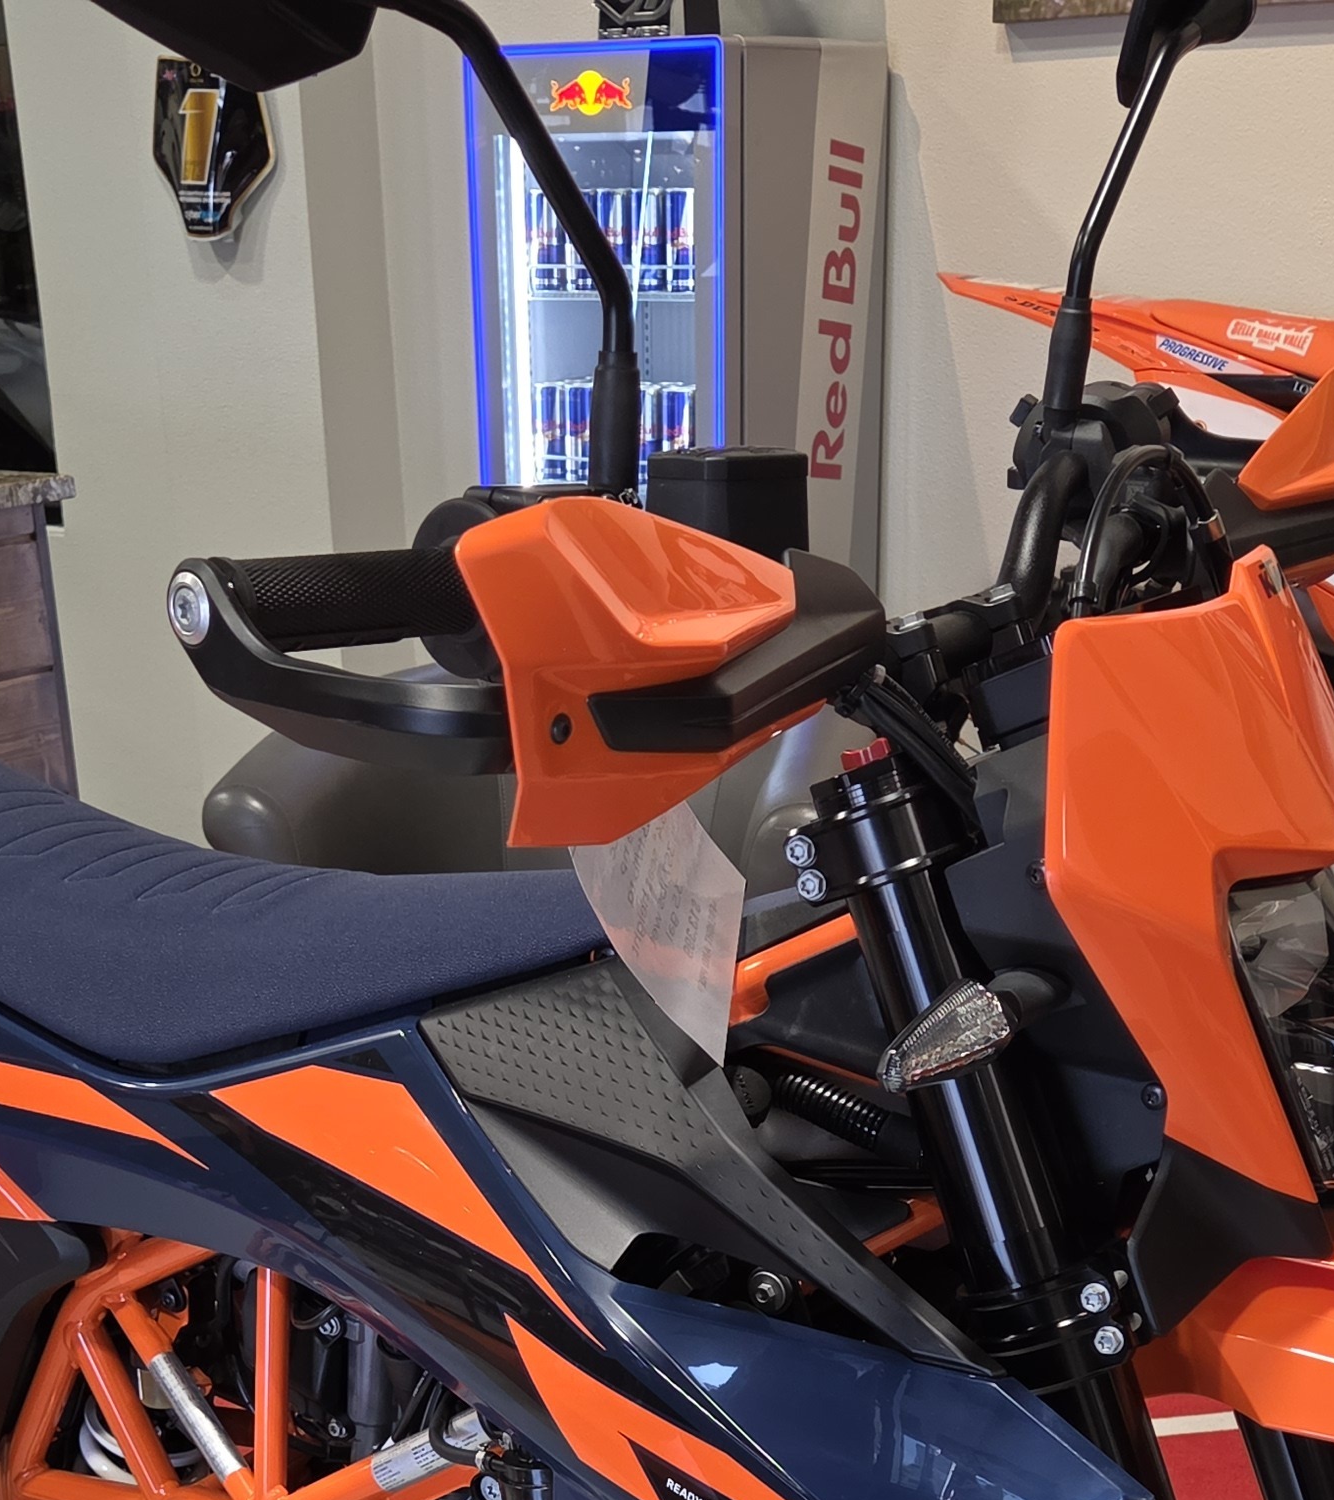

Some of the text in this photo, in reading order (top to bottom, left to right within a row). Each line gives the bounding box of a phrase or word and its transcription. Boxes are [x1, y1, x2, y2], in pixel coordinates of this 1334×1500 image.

[810, 138, 865, 480] Red Bull
[1158, 338, 1229, 372] PROGRESSIVE
